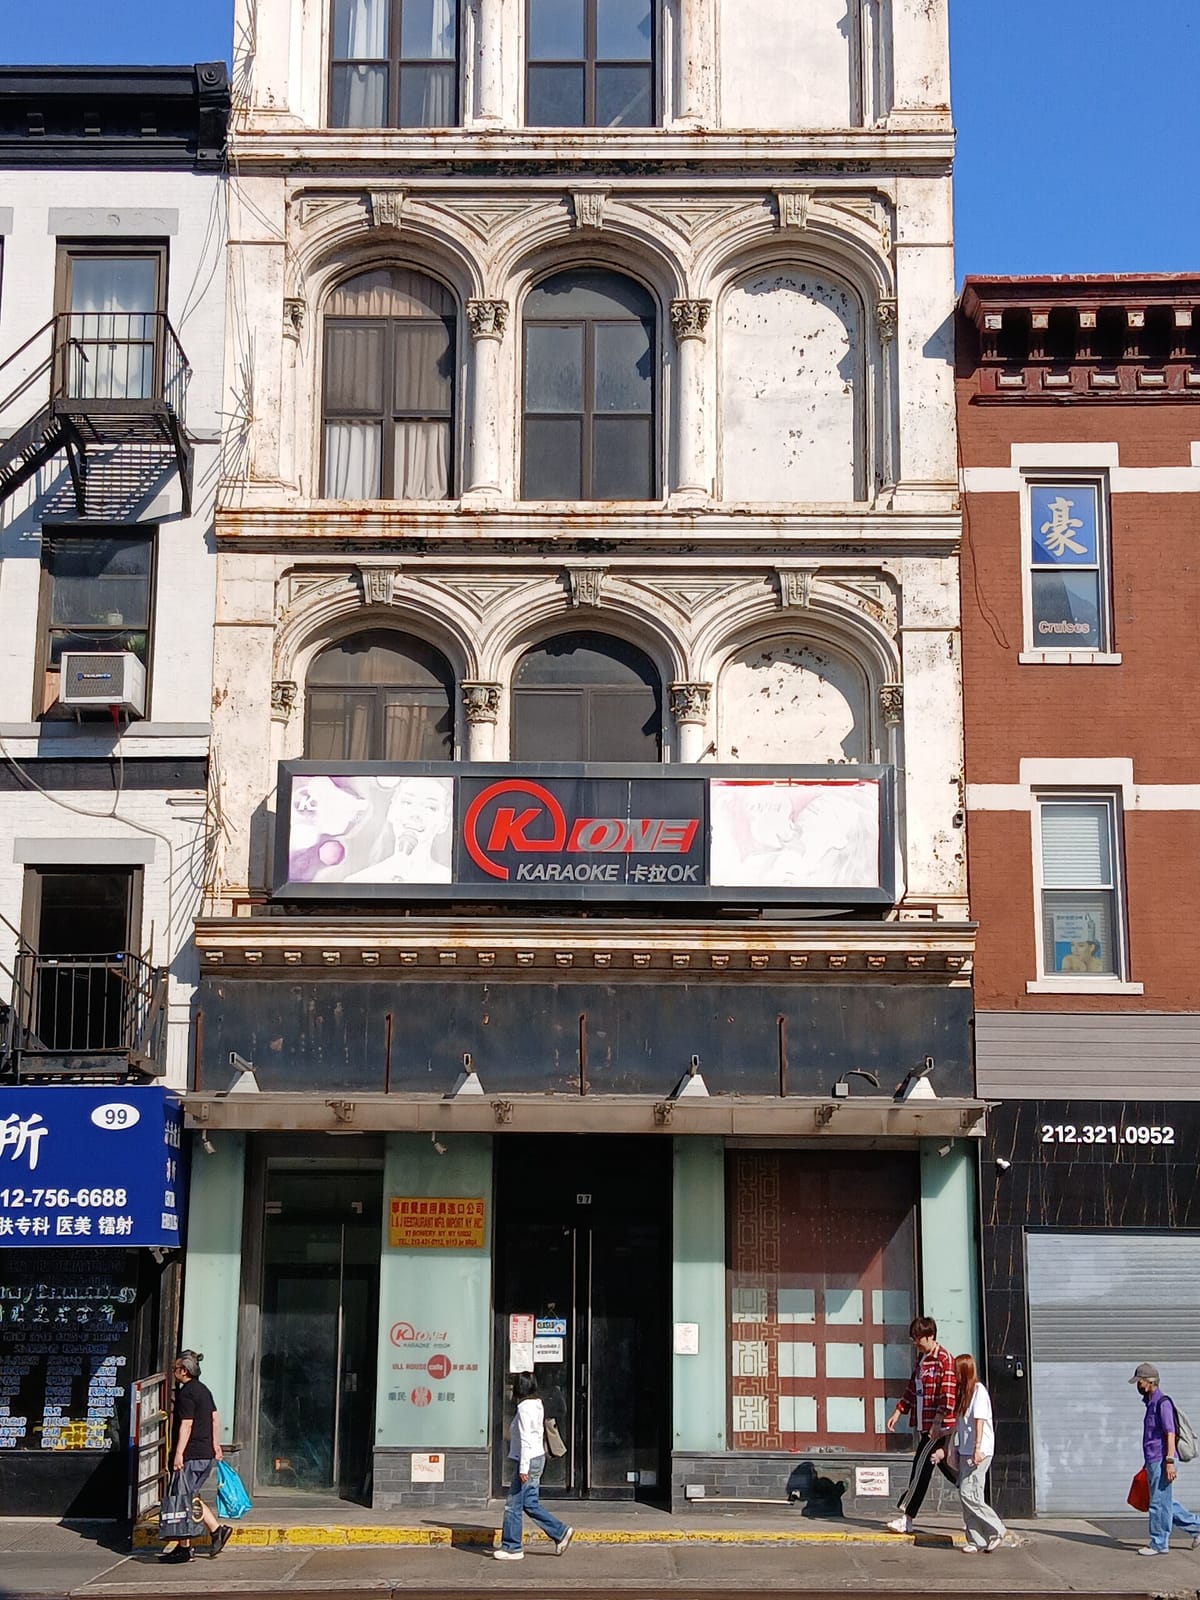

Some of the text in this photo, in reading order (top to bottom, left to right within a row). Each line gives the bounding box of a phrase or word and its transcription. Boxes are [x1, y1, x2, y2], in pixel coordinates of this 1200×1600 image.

[1041, 496, 1088, 557] 豪
[1039, 620, 1089, 634] Cruises
[577, 819, 692, 852] ONE
[516, 863, 700, 883] KARAOKE 卡拉OK
[105, 1109, 128, 1124] 99
[0, 1113, 49, 1171] 所
[1041, 1125, 1175, 1145] 212.321.0952
[0, 1188, 128, 1208] 12-756-6688
[577, 1194, 592, 1204] 97
[56, 1215, 92, 1236] 医美
[98, 1215, 134, 1236] 镭射
